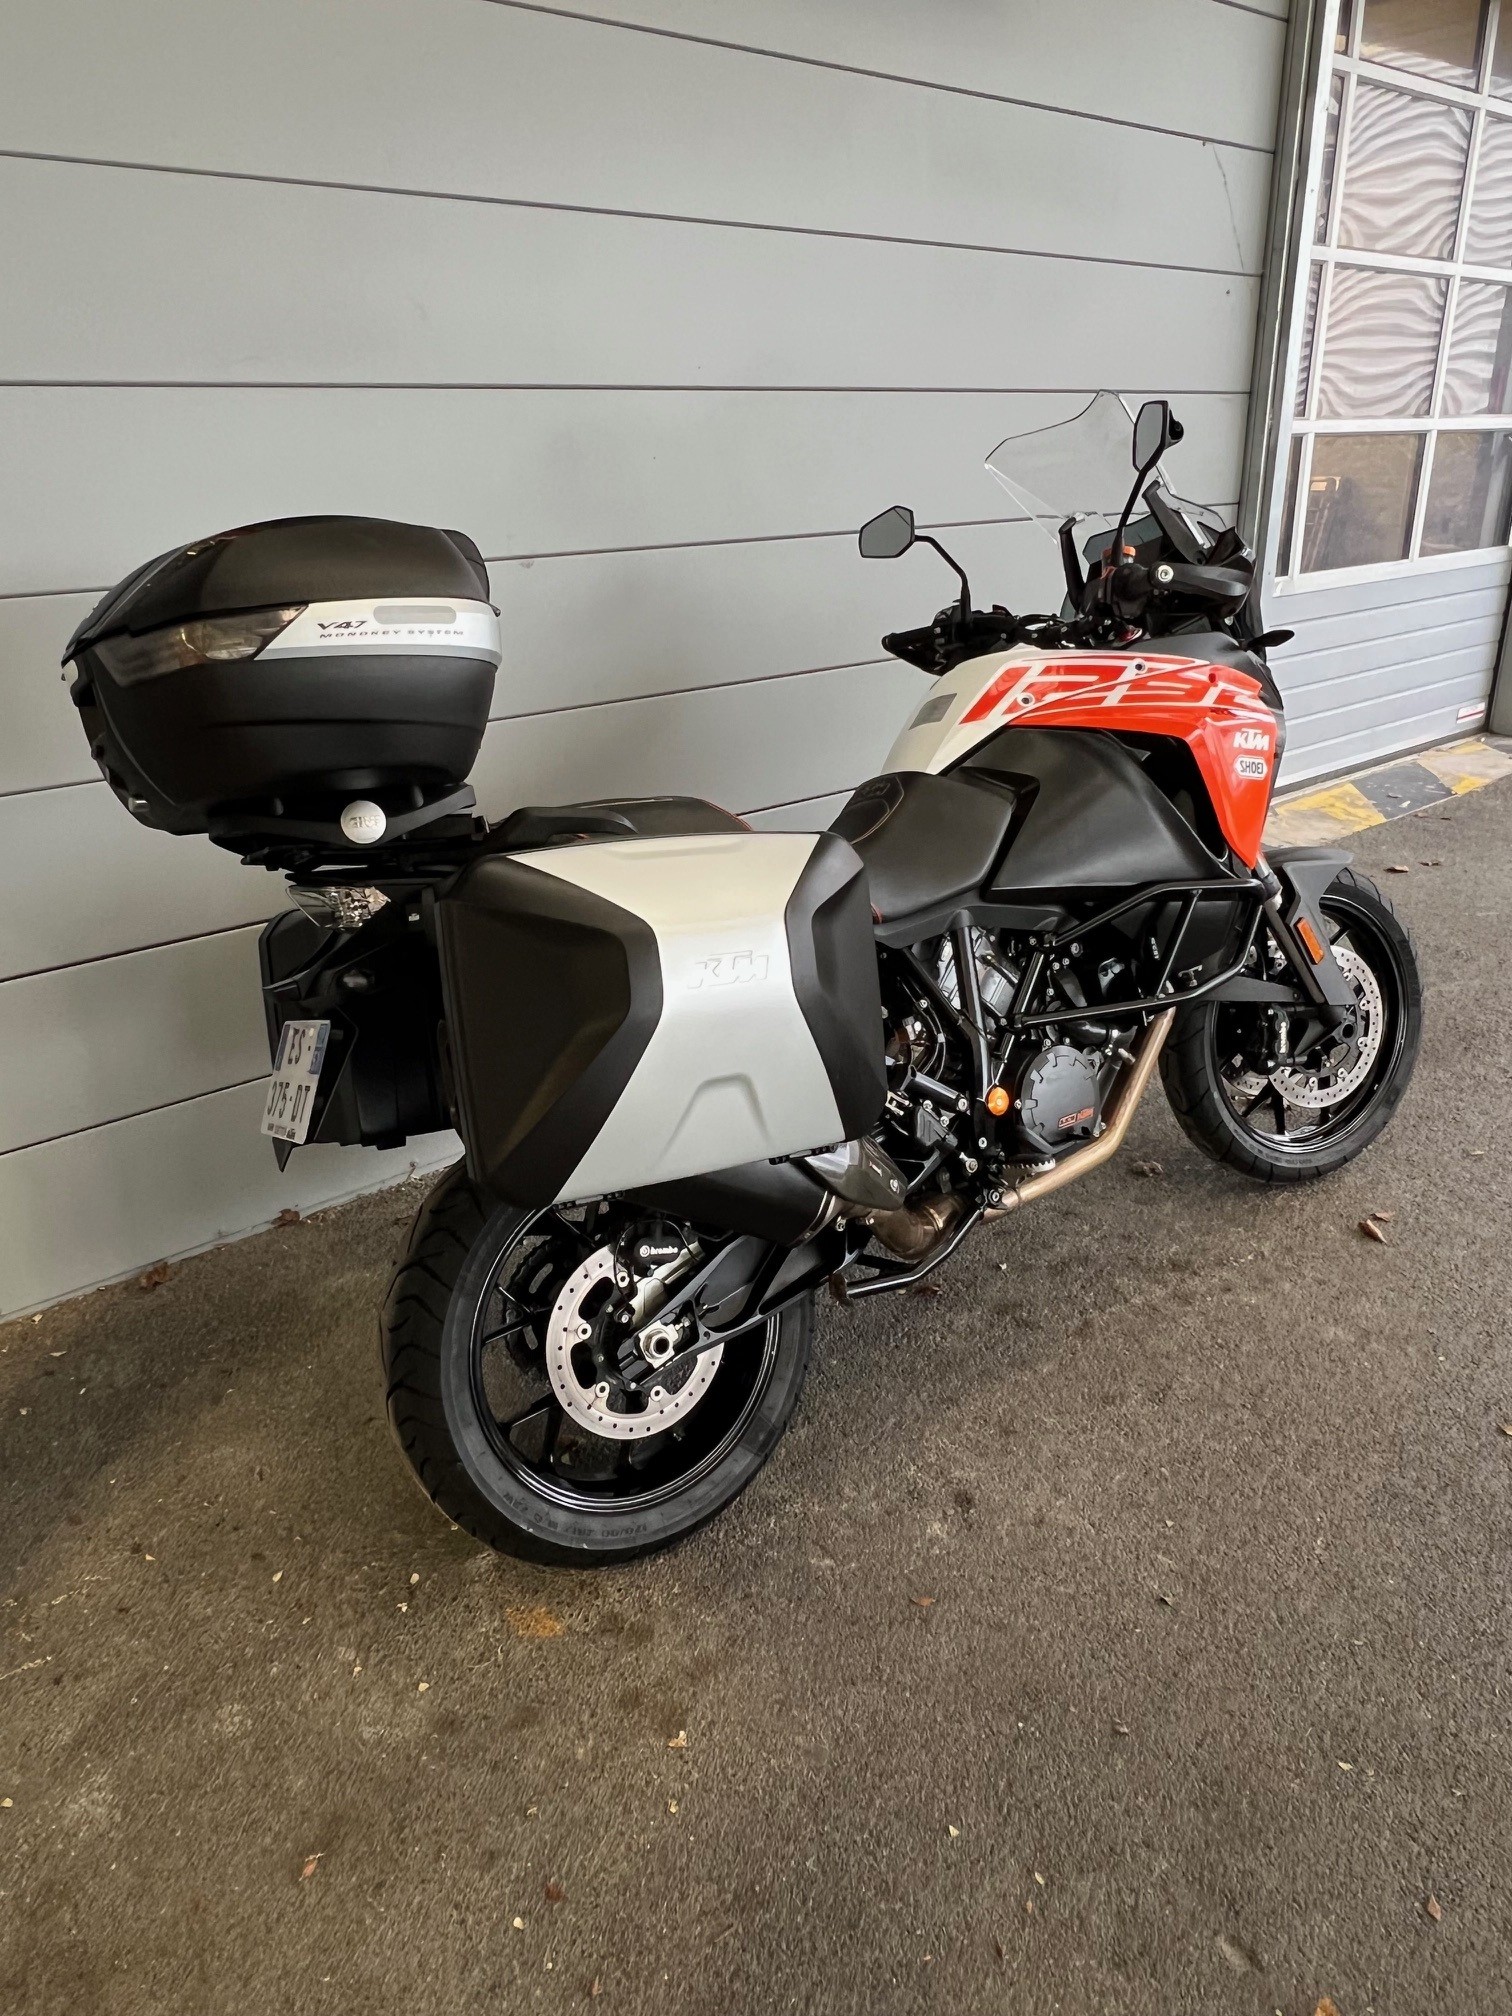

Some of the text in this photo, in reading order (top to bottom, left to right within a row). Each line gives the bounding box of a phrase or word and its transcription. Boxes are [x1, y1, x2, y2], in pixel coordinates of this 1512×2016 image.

[317, 620, 368, 630] V47
[1233, 727, 1270, 751] KTM
[687, 949, 770, 989] KTM
